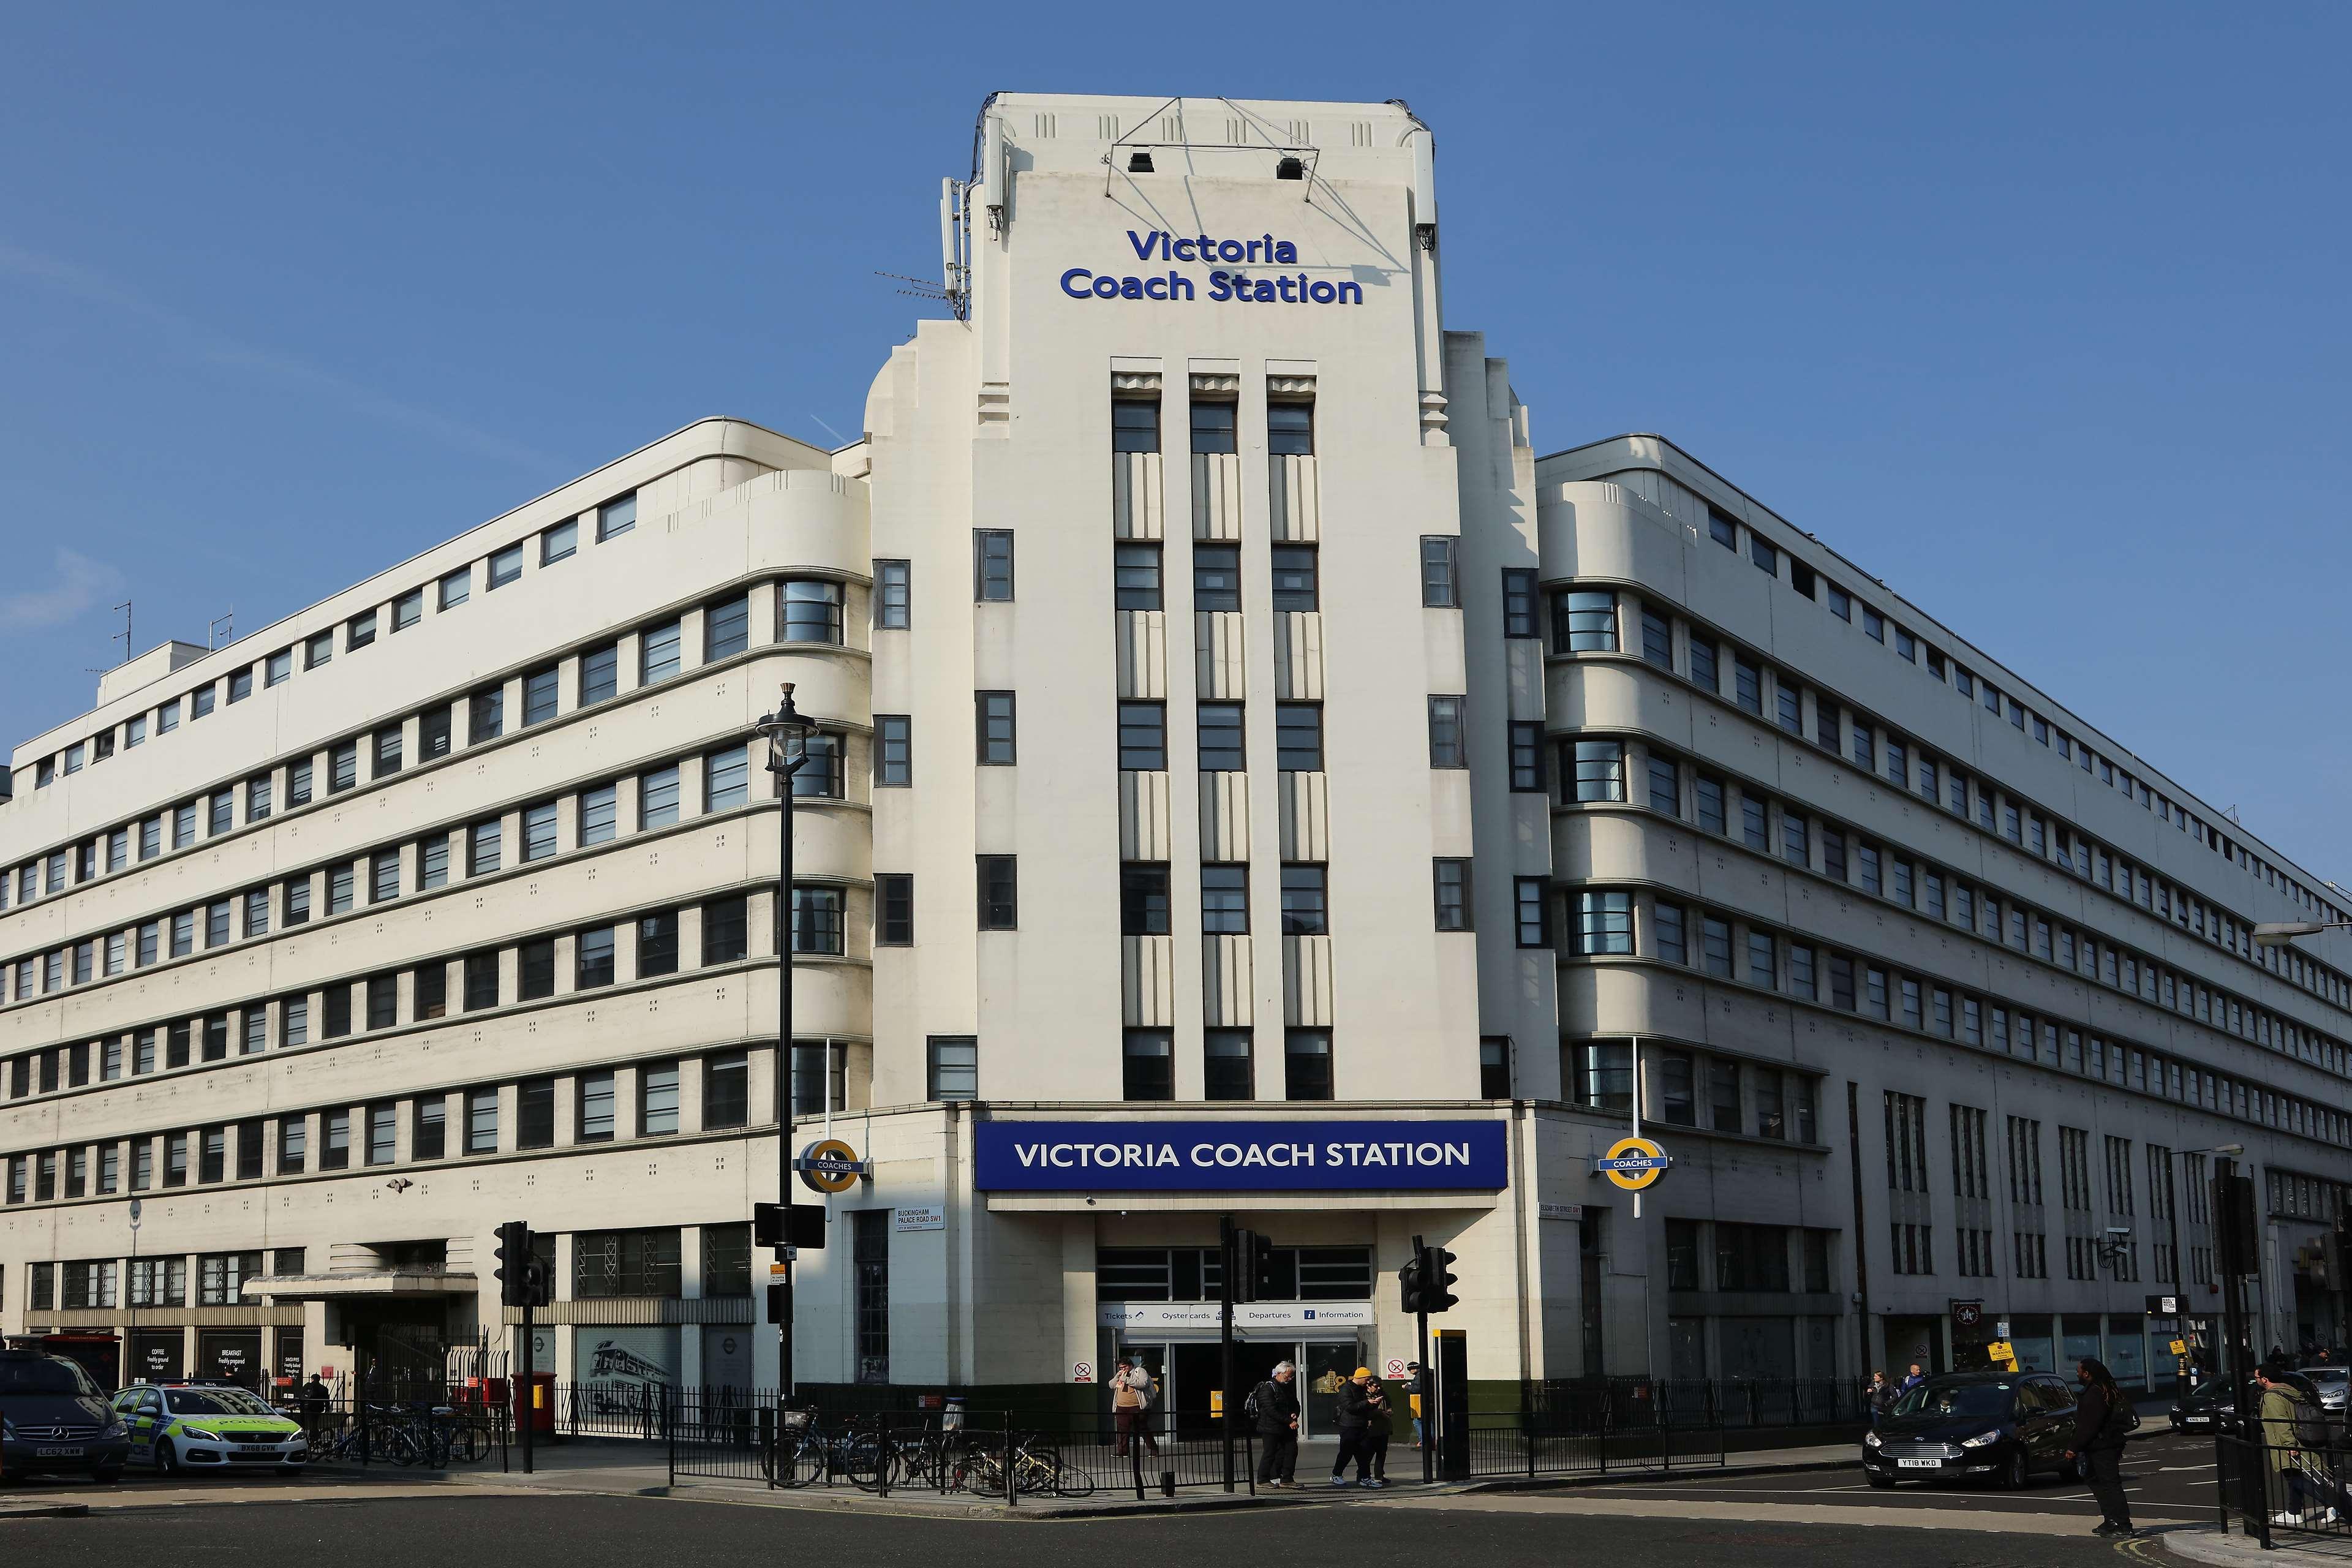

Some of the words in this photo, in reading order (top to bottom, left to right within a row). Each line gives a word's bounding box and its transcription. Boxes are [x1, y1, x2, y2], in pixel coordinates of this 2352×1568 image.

[1126, 230, 1297, 263] Victoria
[1060, 268, 1194, 301] Coach
[1208, 271, 1363, 304] Station
[1014, 1143, 1180, 1167] VICTORIA
[1191, 1143, 1314, 1167] COACH
[1325, 1142, 1469, 1166] STATION
[1162, 1313, 1188, 1321] Oyster
